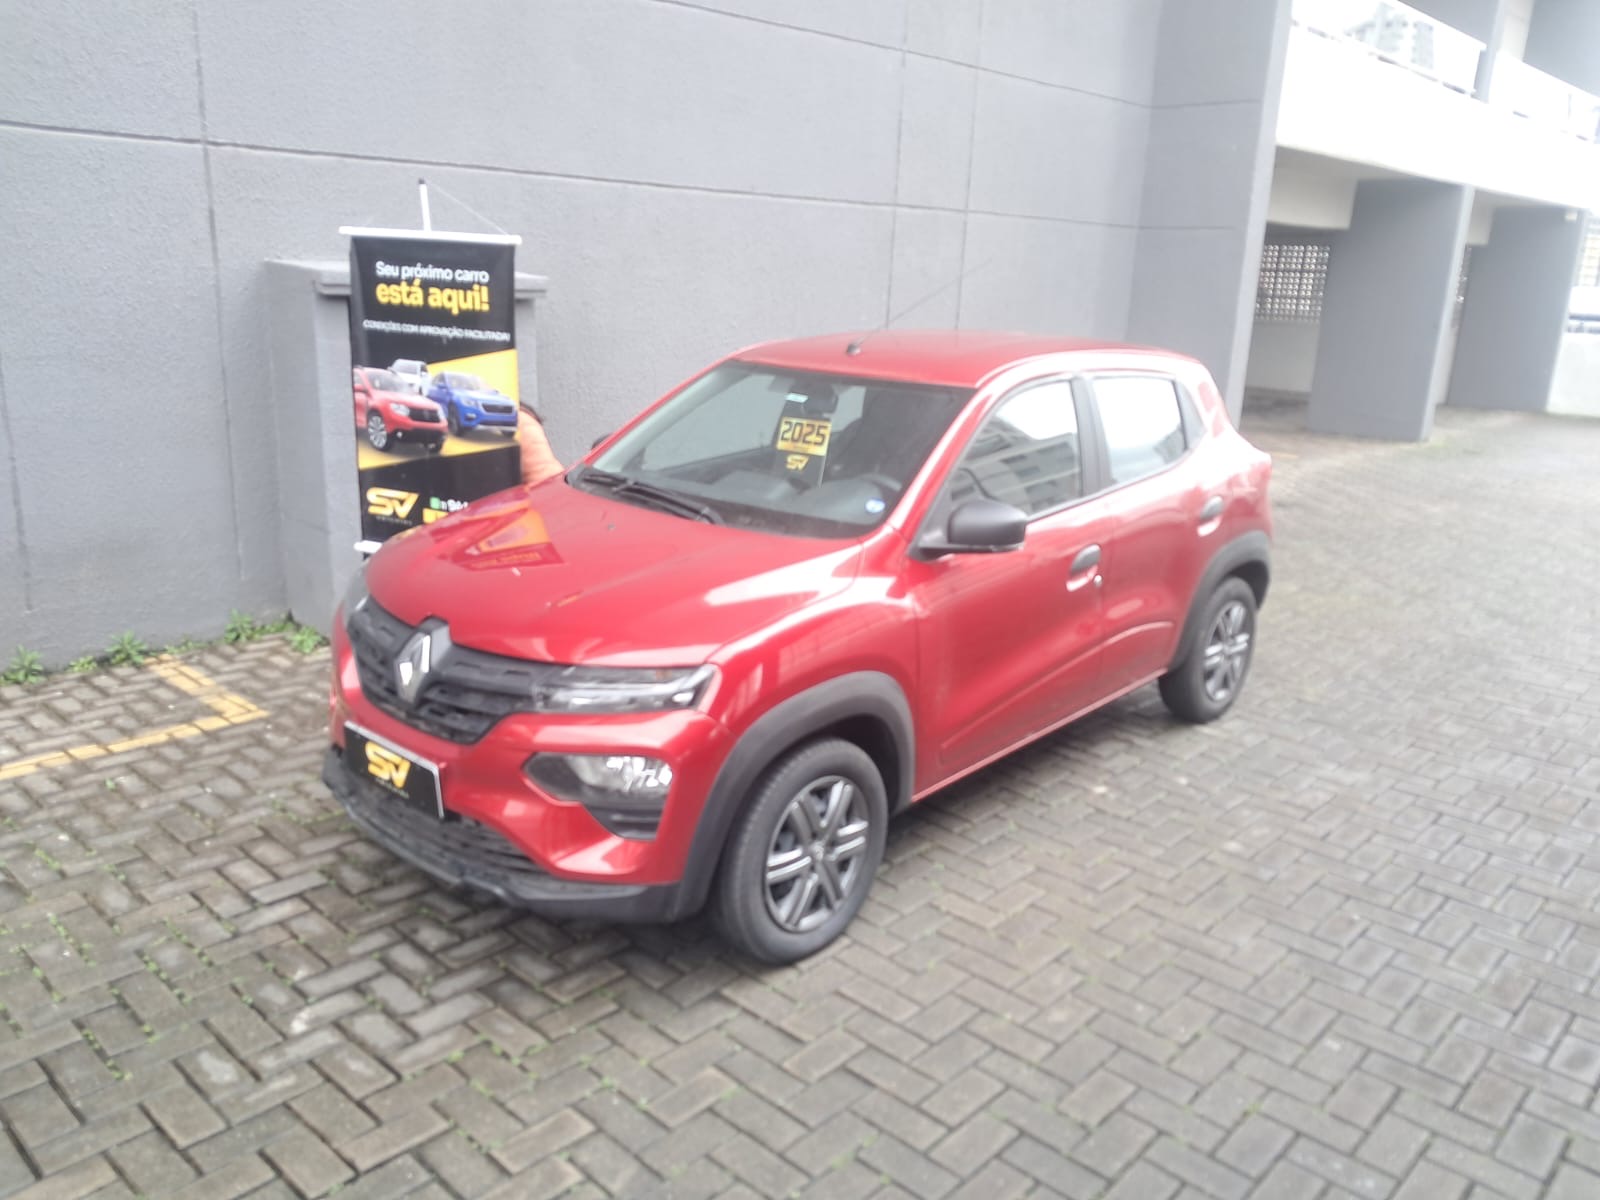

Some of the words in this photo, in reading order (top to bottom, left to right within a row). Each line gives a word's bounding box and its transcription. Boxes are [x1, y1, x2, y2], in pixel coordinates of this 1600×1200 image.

[375, 261, 400, 277] Seu
[401, 263, 453, 281] próximo
[455, 268, 490, 283] carro
[376, 279, 424, 307] está
[428, 284, 490, 316] aqui!
[780, 420, 828, 446] 2025
[366, 486, 420, 519] SV
